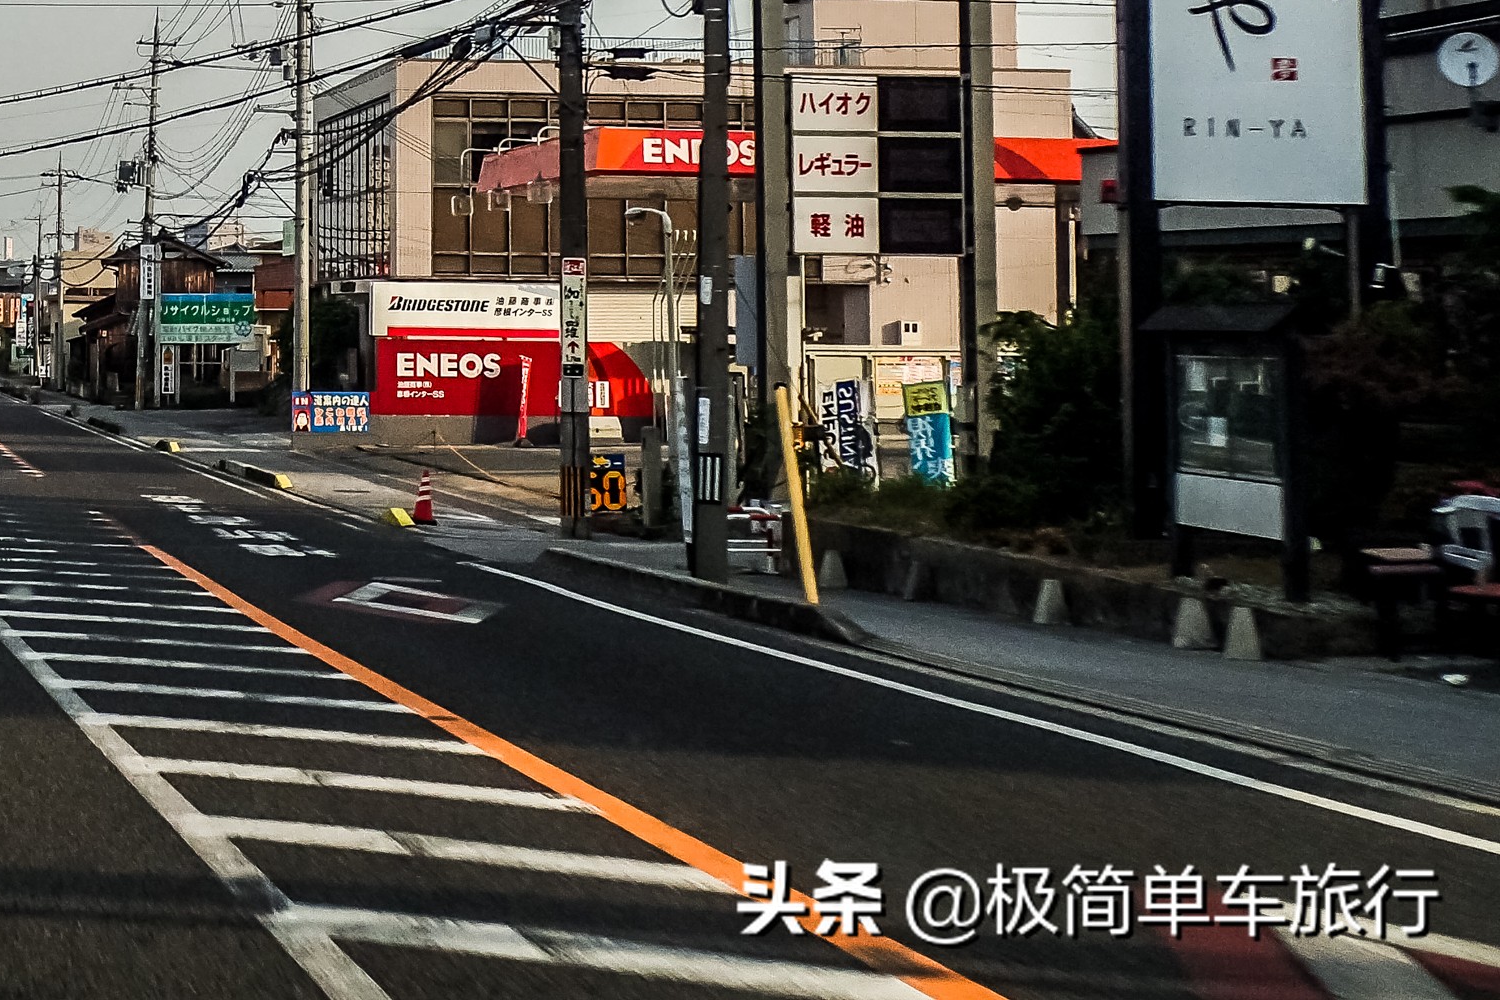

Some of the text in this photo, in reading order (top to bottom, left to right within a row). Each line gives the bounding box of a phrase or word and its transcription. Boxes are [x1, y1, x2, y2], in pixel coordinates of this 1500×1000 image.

[799, 92, 872, 116] ハイオク
[799, 153, 872, 177] レギュラー
[810, 213, 865, 238] 軽油
[388, 296, 490, 312] BRIDGESTONE
[397, 352, 501, 379] ENEOS
